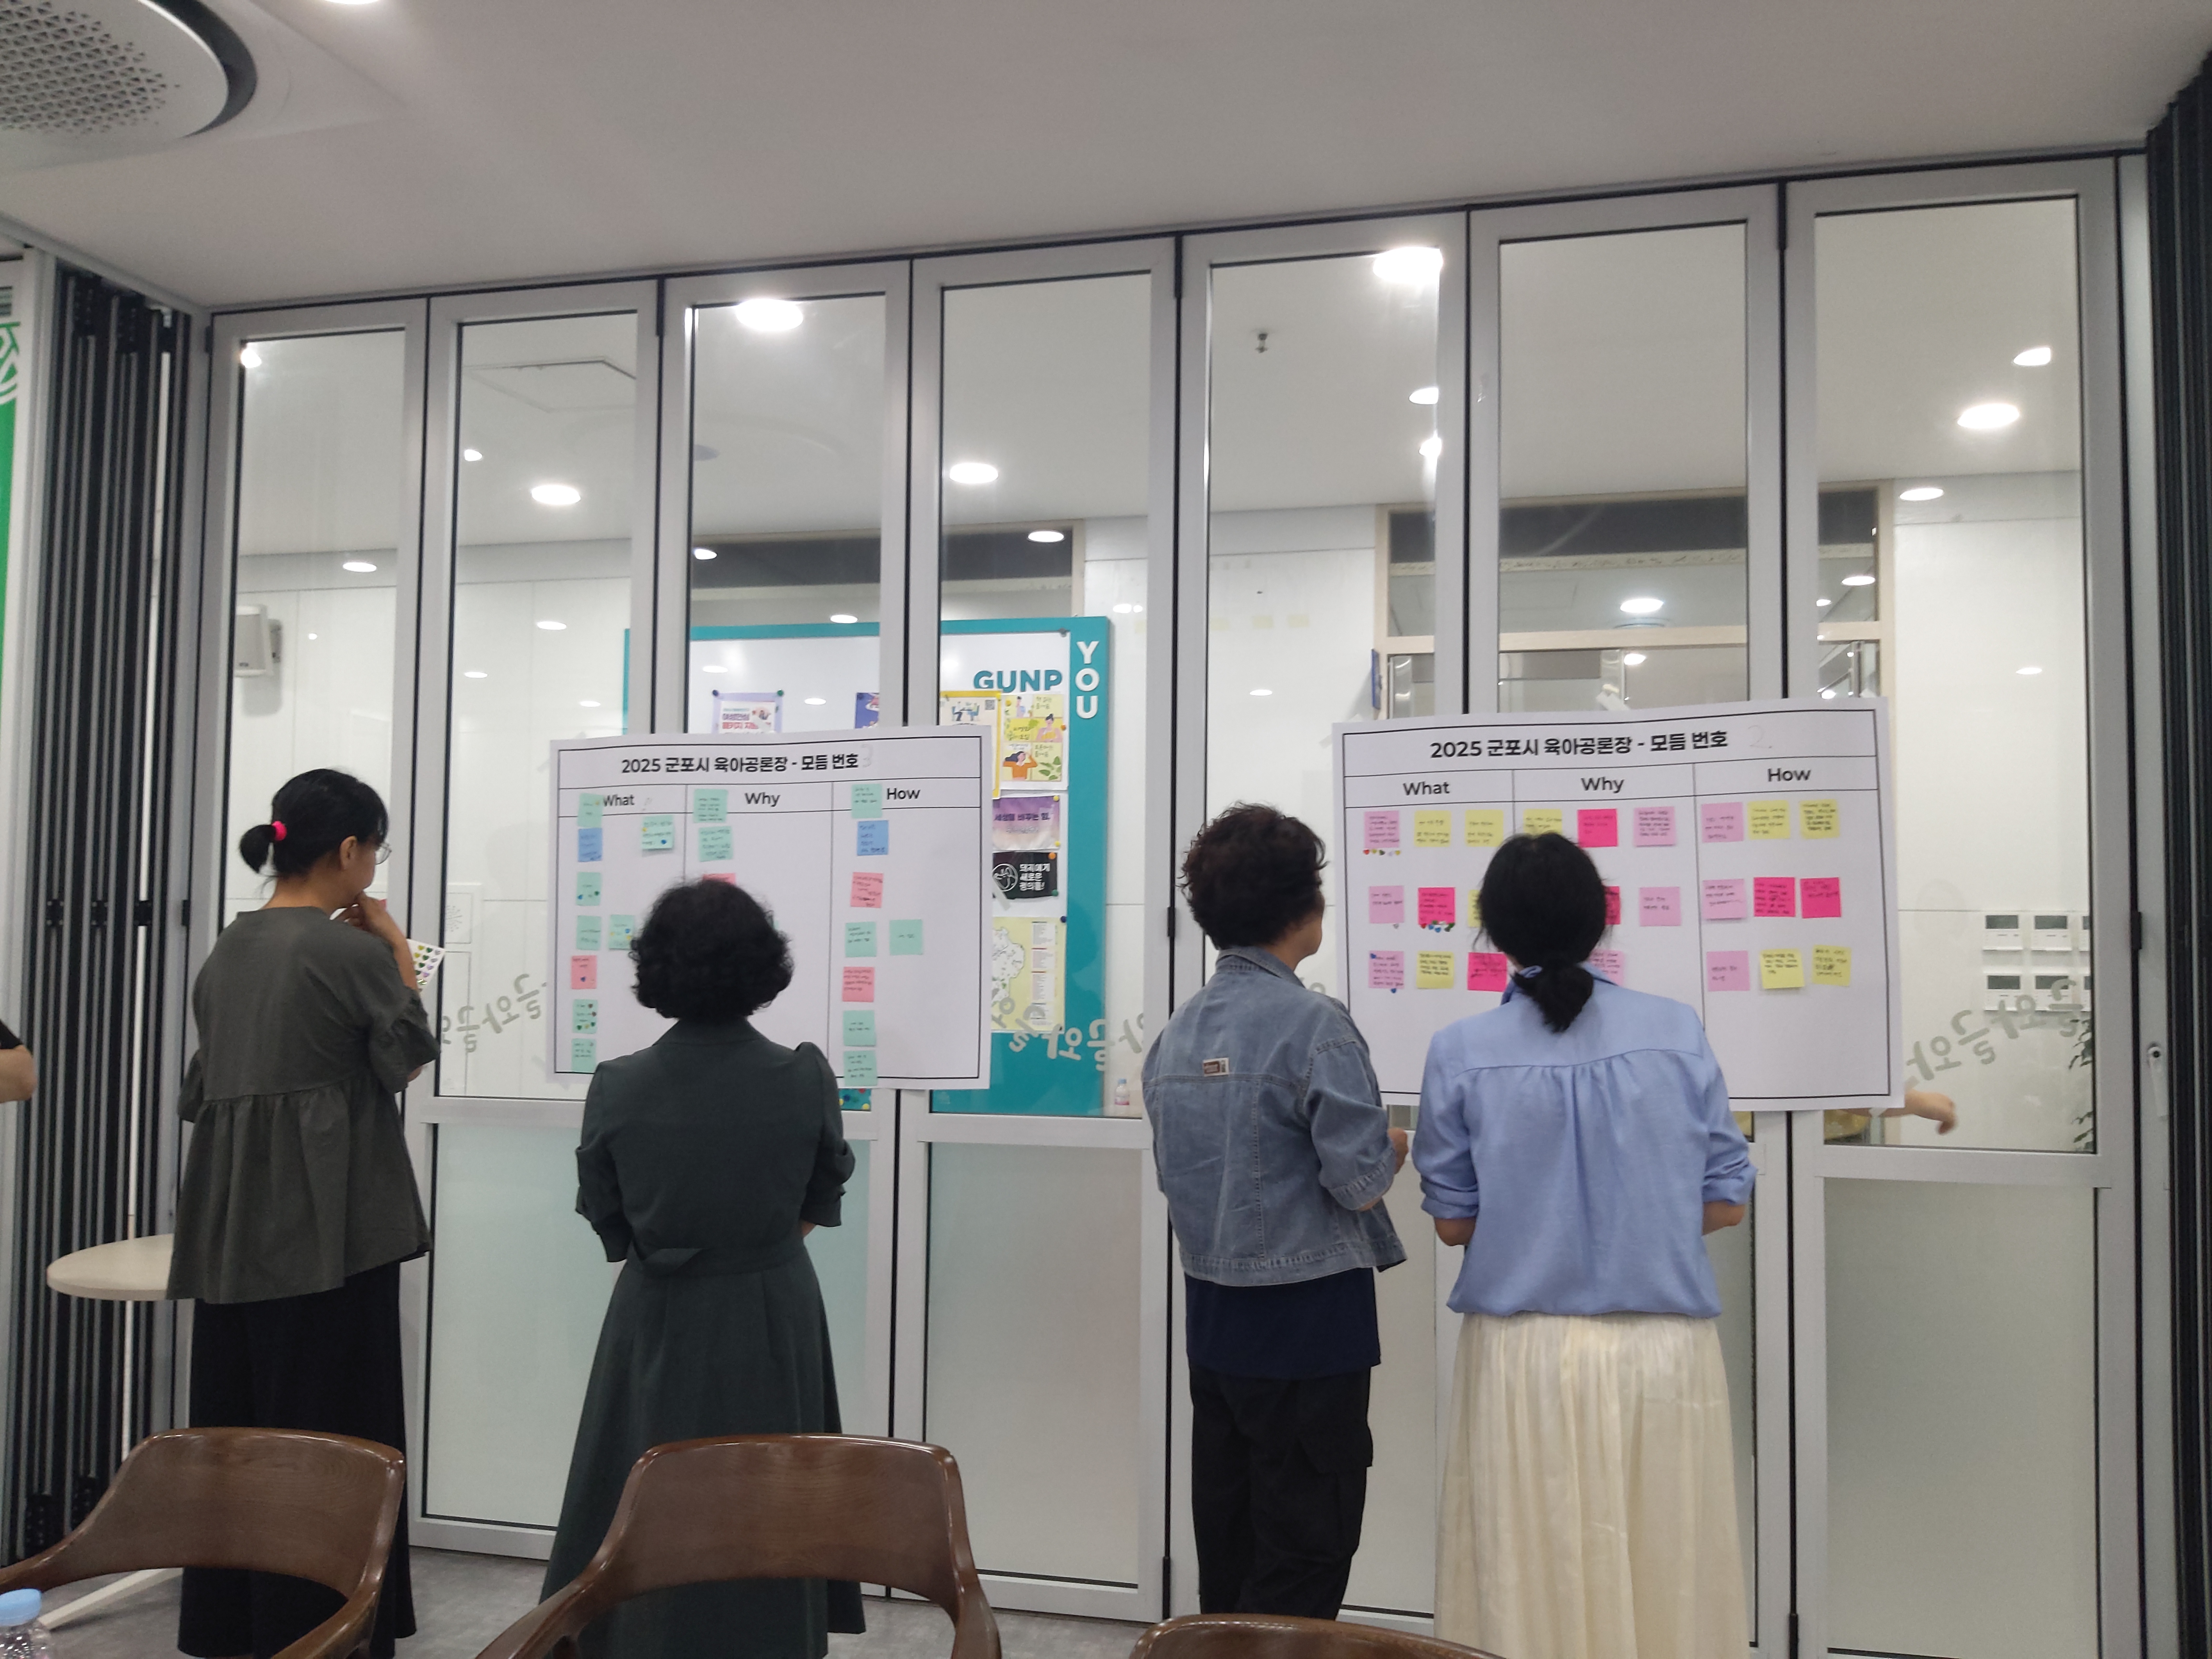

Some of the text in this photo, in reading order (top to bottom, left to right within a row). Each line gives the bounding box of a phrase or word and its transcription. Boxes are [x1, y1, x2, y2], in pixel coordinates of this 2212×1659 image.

[974, 669, 1062, 693] GUNP
[1076, 640, 1100, 719] YOU
[1430, 743, 1482, 758] 2025
[1487, 739, 1538, 756] 군포시
[1544, 737, 1632, 755] 육아공론장
[1651, 733, 1686, 751] 모듬
[1692, 731, 1728, 749] 번호
[622, 758, 660, 773] 2025
[665, 757, 709, 772] 군포시
[714, 756, 788, 772] 육아공론장
[801, 755, 828, 770] 모듬
[832, 753, 858, 769] 번호
[1768, 768, 1811, 782] How
[887, 787, 920, 800] How
[1403, 781, 1450, 796] What
[1581, 777, 1624, 794] Why
[602, 794, 635, 807] What
[745, 792, 780, 807] Why
